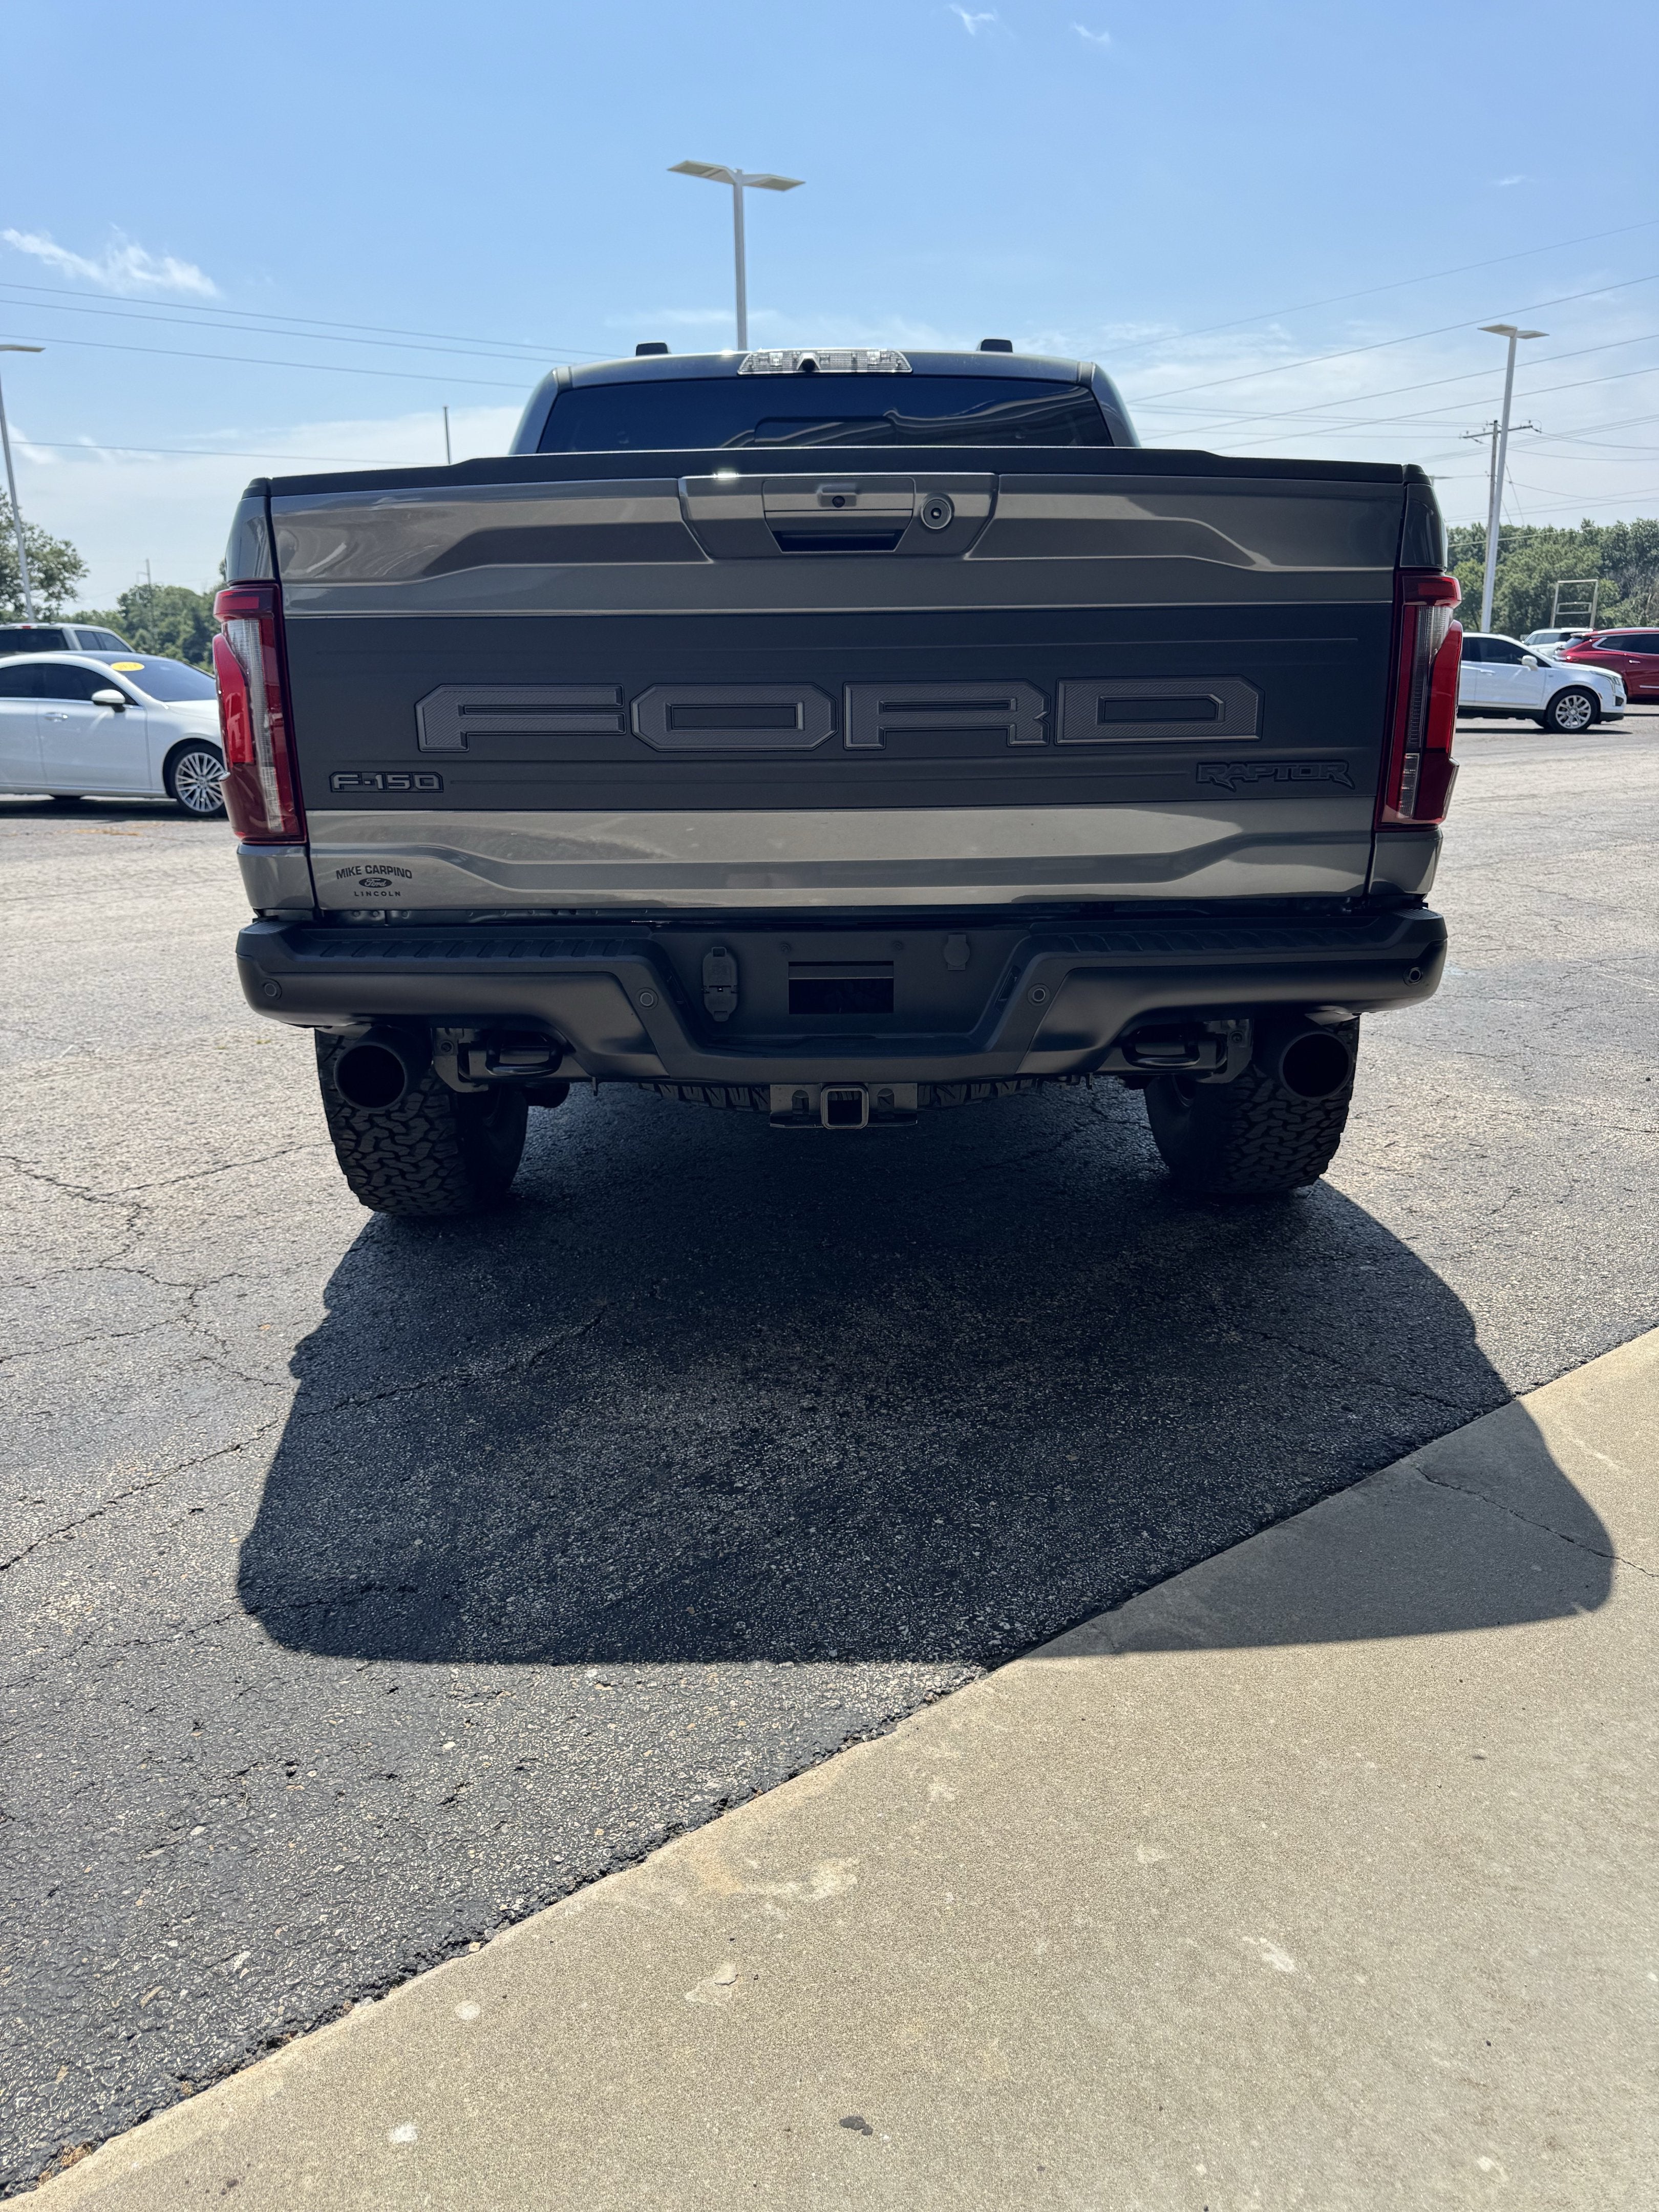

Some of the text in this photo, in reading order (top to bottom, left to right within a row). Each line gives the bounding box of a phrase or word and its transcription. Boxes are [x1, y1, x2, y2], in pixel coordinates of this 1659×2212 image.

[415, 675, 1264, 751] FORD
[332, 773, 441, 791] F-150
[1196, 760, 1355, 792] RAPTOR
[336, 865, 412, 879] MIKE CARPINO
[364, 878, 387, 887] Ford
